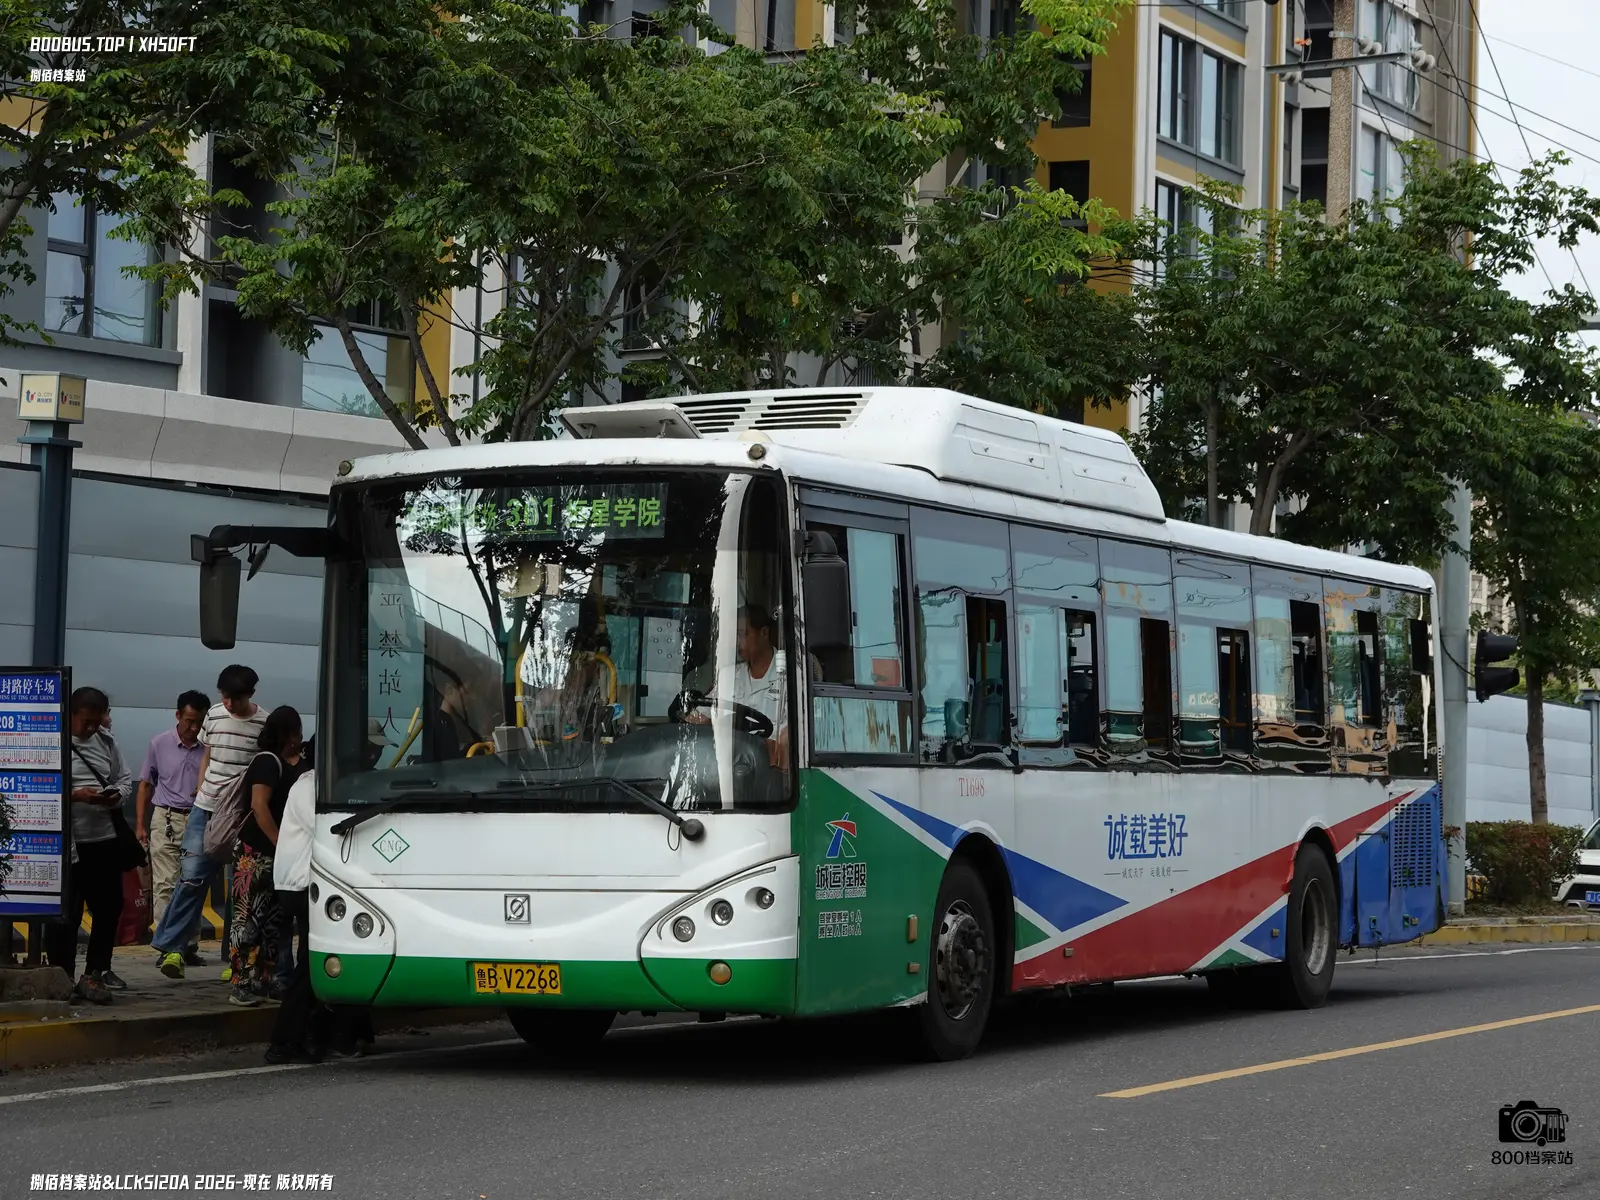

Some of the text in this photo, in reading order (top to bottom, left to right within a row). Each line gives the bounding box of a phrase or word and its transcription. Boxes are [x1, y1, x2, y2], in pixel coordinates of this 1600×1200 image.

[0, 715, 15, 730] 08
[0, 776, 15, 790] 61
[959, 777, 985, 798] T1698
[1104, 813, 1188, 860] 诚载美好
[379, 839, 402, 853] CNG
[815, 862, 867, 890] 城运控股
